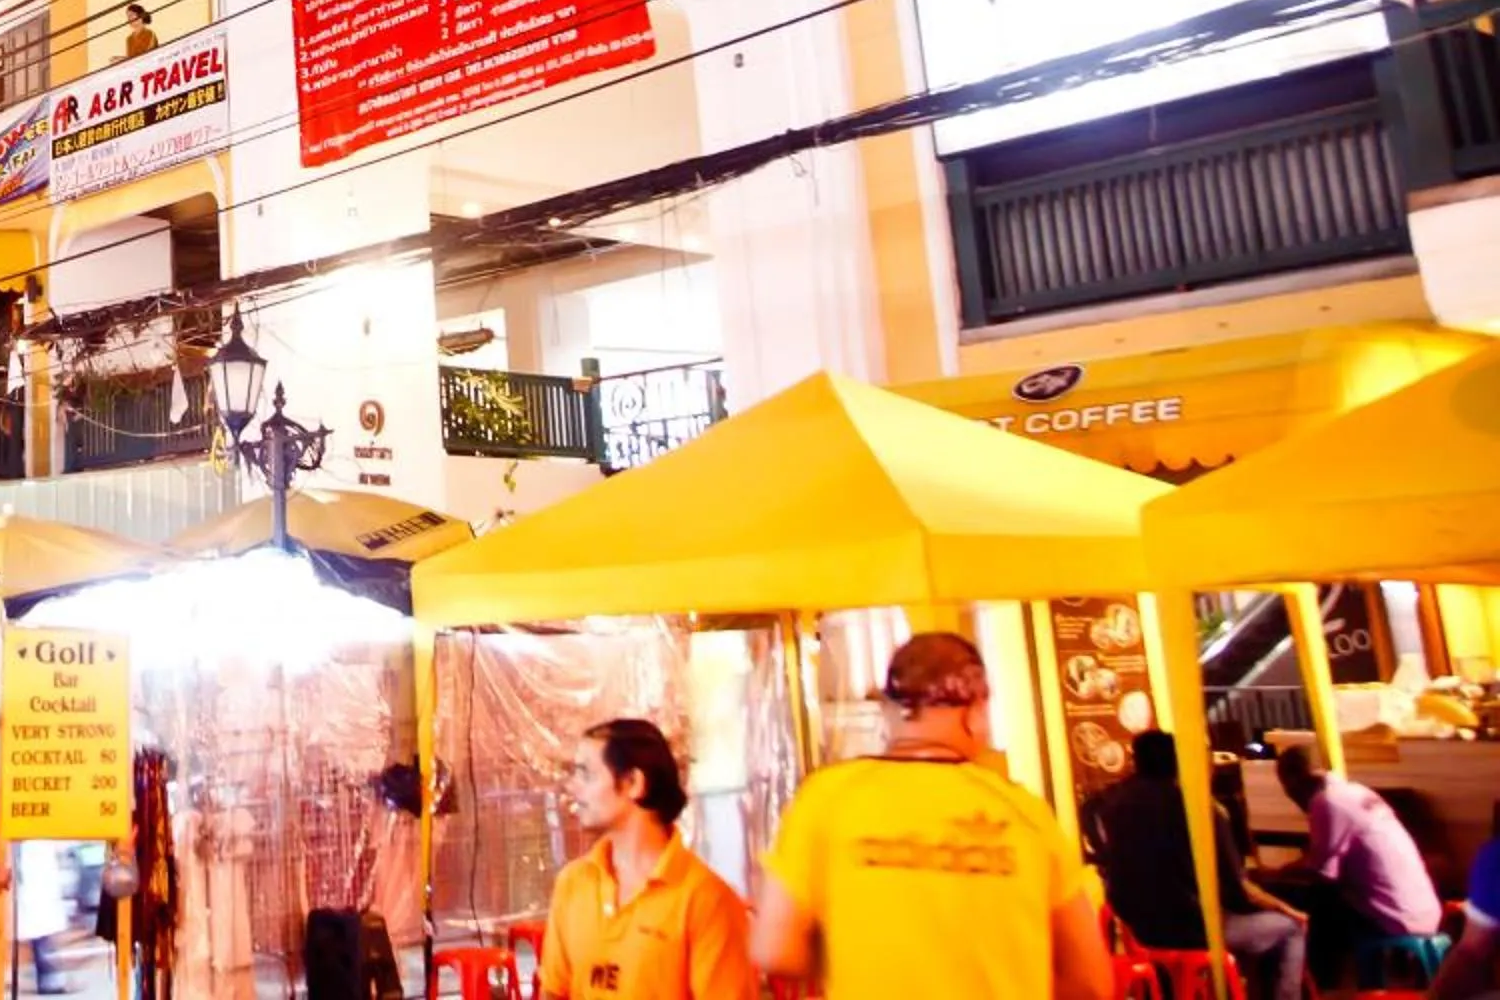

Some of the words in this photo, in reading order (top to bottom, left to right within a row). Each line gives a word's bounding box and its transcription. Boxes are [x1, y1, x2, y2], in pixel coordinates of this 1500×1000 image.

[88, 81, 133, 120] A&R
[140, 48, 223, 100] TRAVEL
[1024, 396, 1183, 434] COFFEE
[53, 672, 78, 688] Bar
[30, 696, 96, 713] Cocktail
[12, 724, 50, 740] VERY
[56, 724, 116, 739] STRONG
[11, 750, 86, 765] COCKTAIL
[12, 776, 71, 792] BUCKET
[11, 801, 49, 817] BEER
